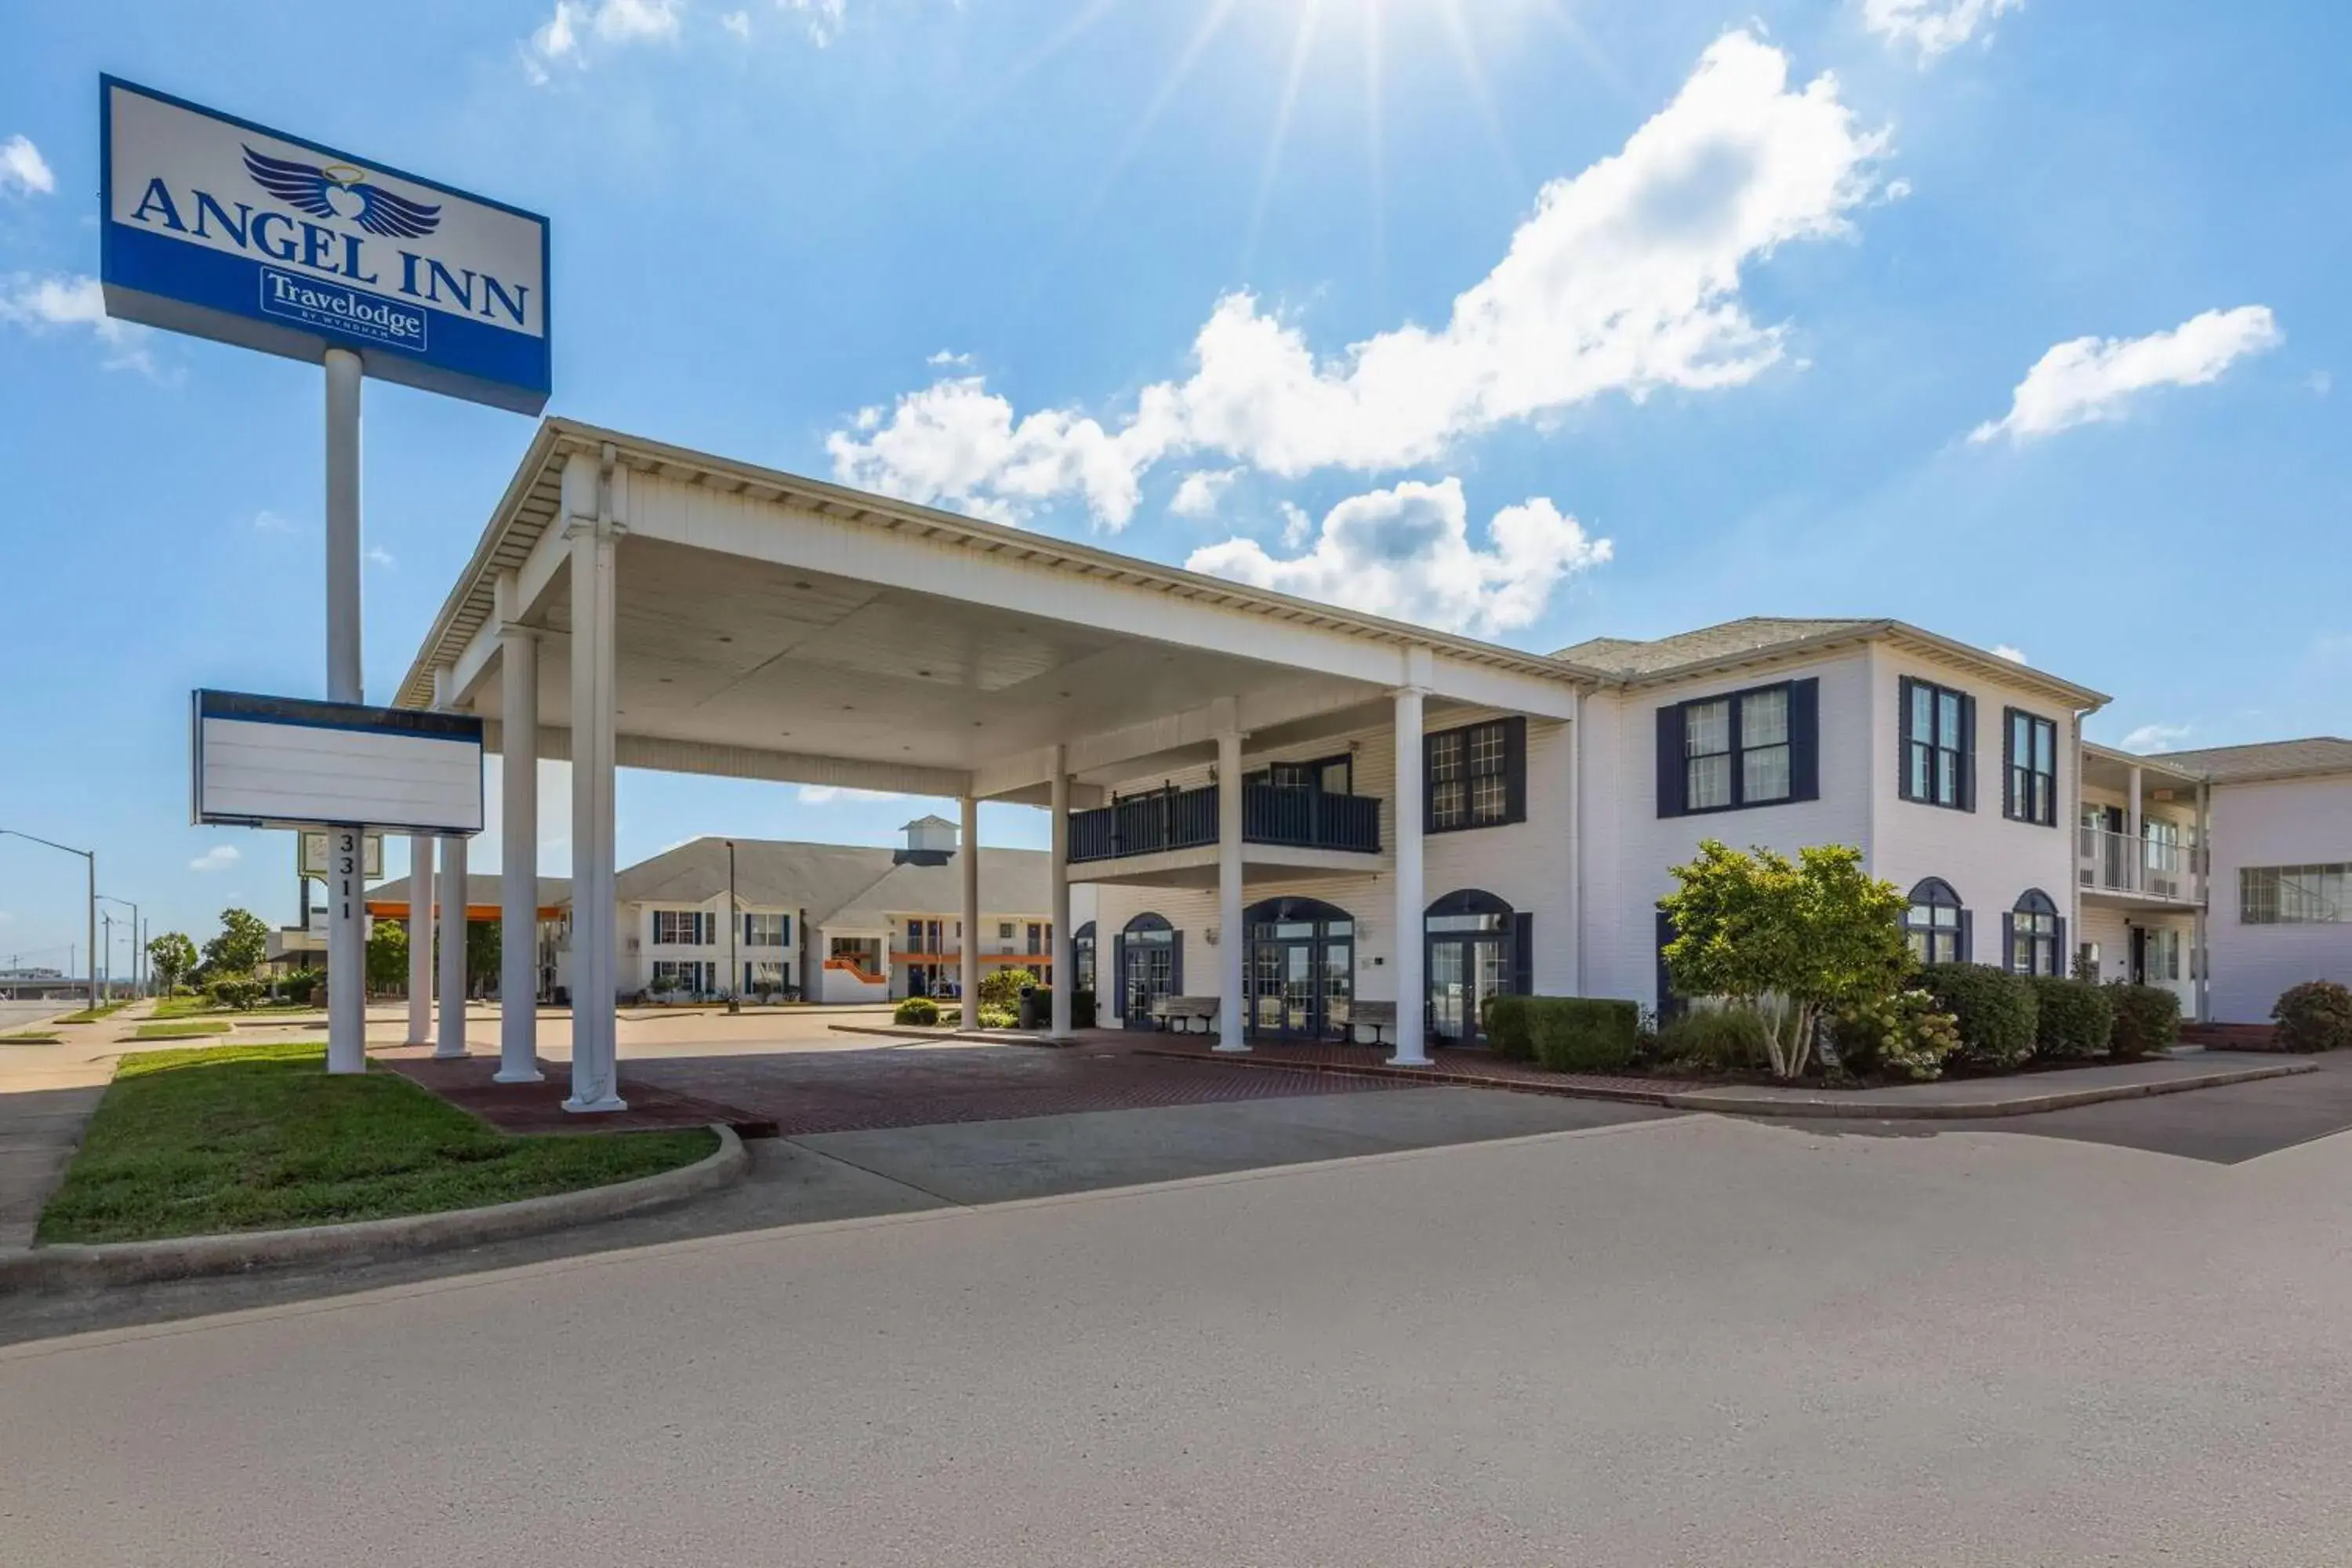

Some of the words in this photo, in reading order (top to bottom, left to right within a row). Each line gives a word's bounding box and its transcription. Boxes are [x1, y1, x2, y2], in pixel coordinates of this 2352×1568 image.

[130, 177, 379, 285] ANGEL
[398, 250, 529, 325] INN
[268, 272, 421, 336] Travelodge
[302, 310, 316, 321] BY
[323, 318, 389, 339] WYNDHAM
[339, 834, 354, 919] 3311
